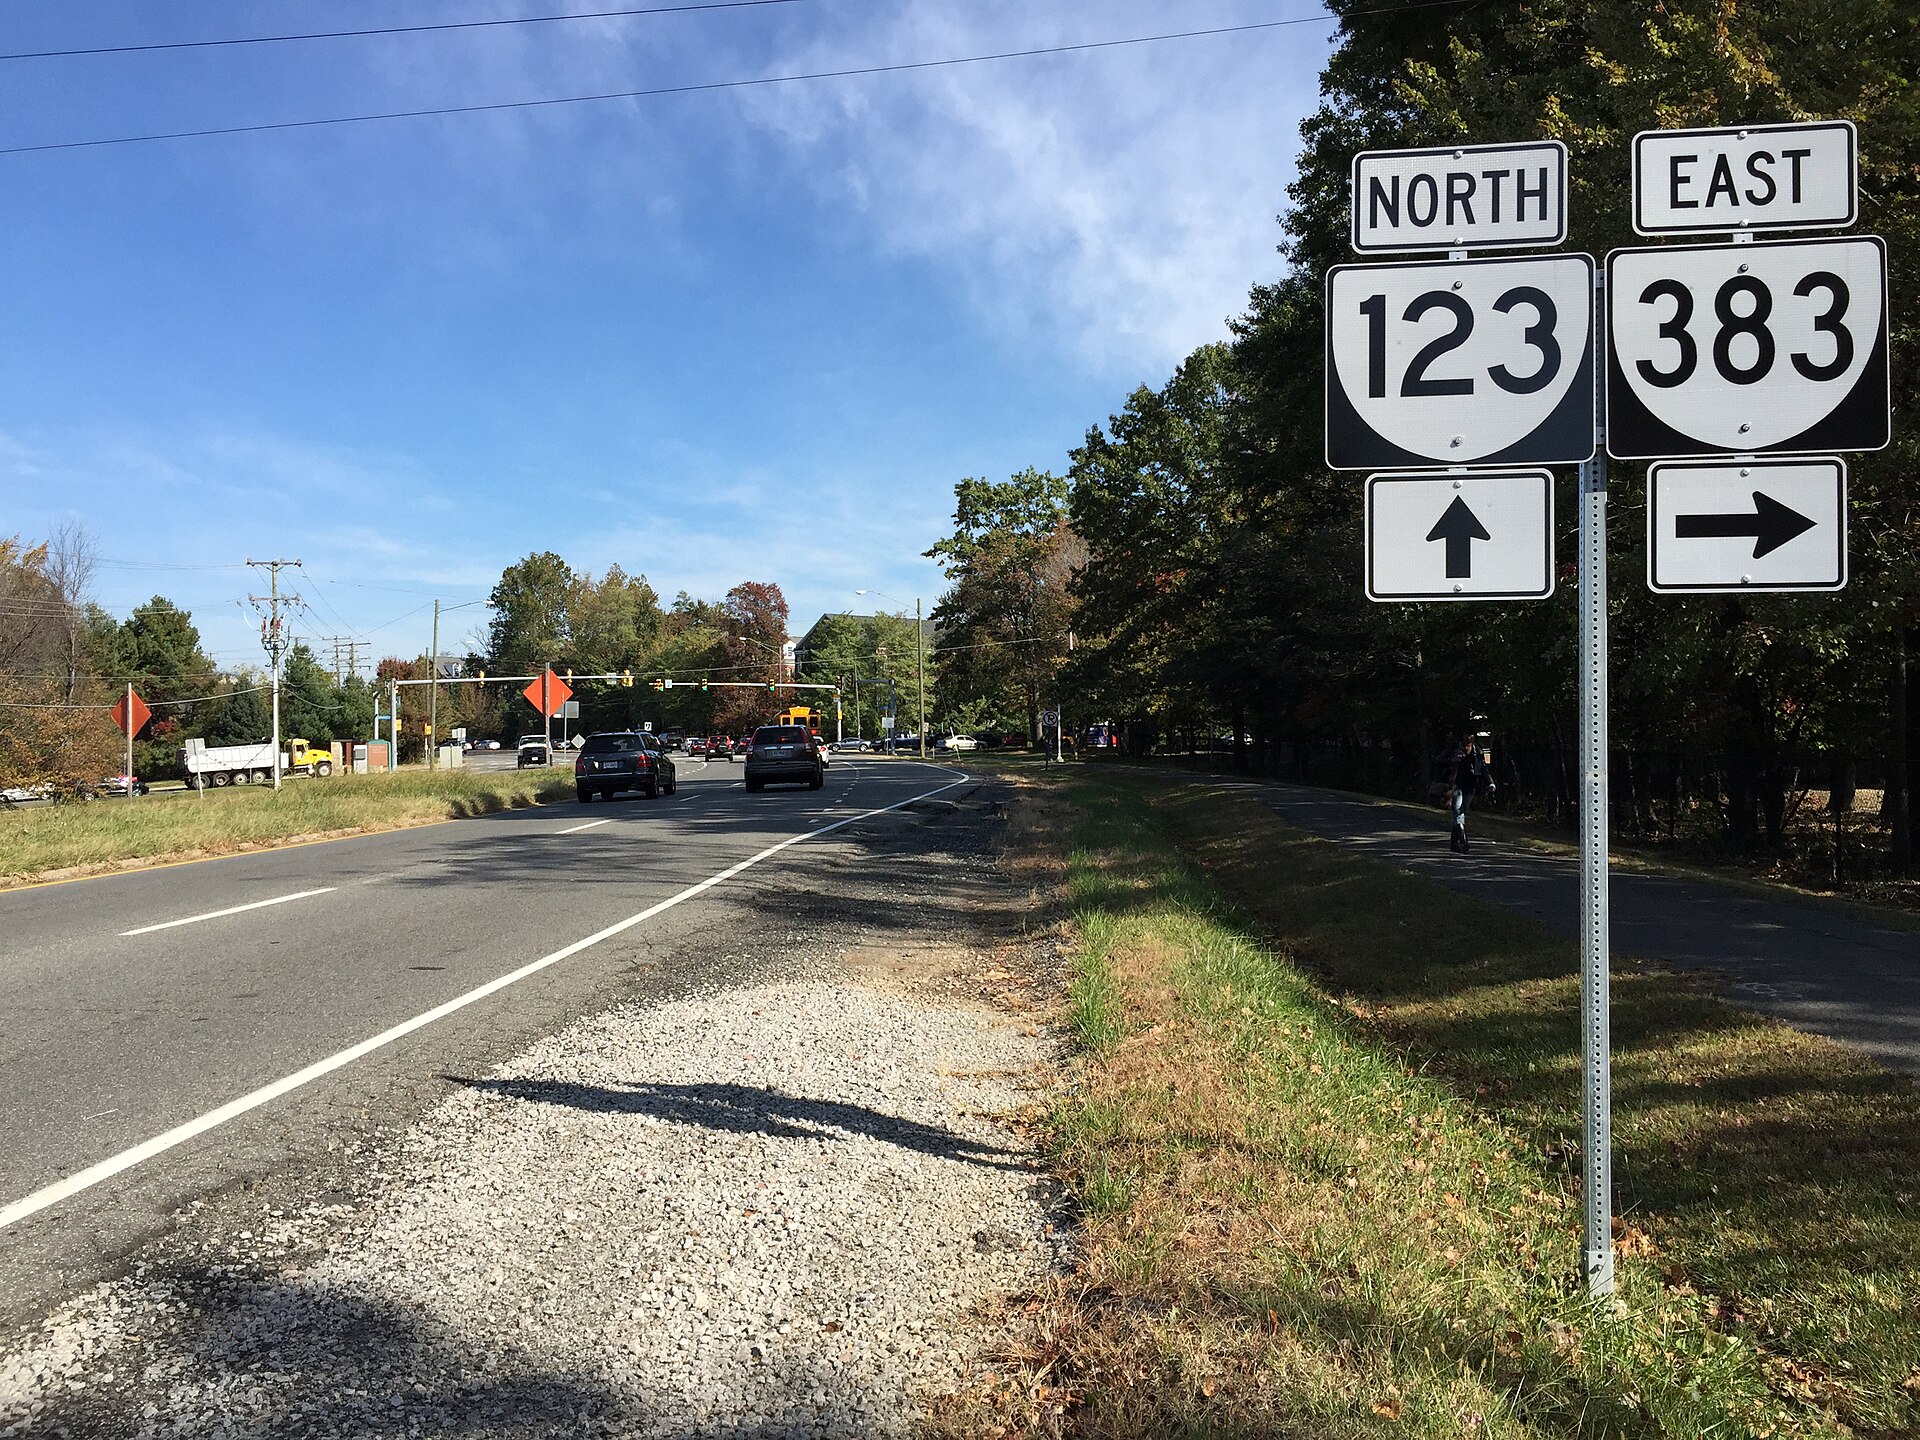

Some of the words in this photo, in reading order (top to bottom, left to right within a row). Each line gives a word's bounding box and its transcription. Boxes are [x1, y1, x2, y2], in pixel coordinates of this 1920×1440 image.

[1369, 167, 1548, 229] NORTH
[1669, 148, 1811, 209] EAST
[1359, 285, 1562, 399] 123
[1635, 270, 1854, 389] 383
